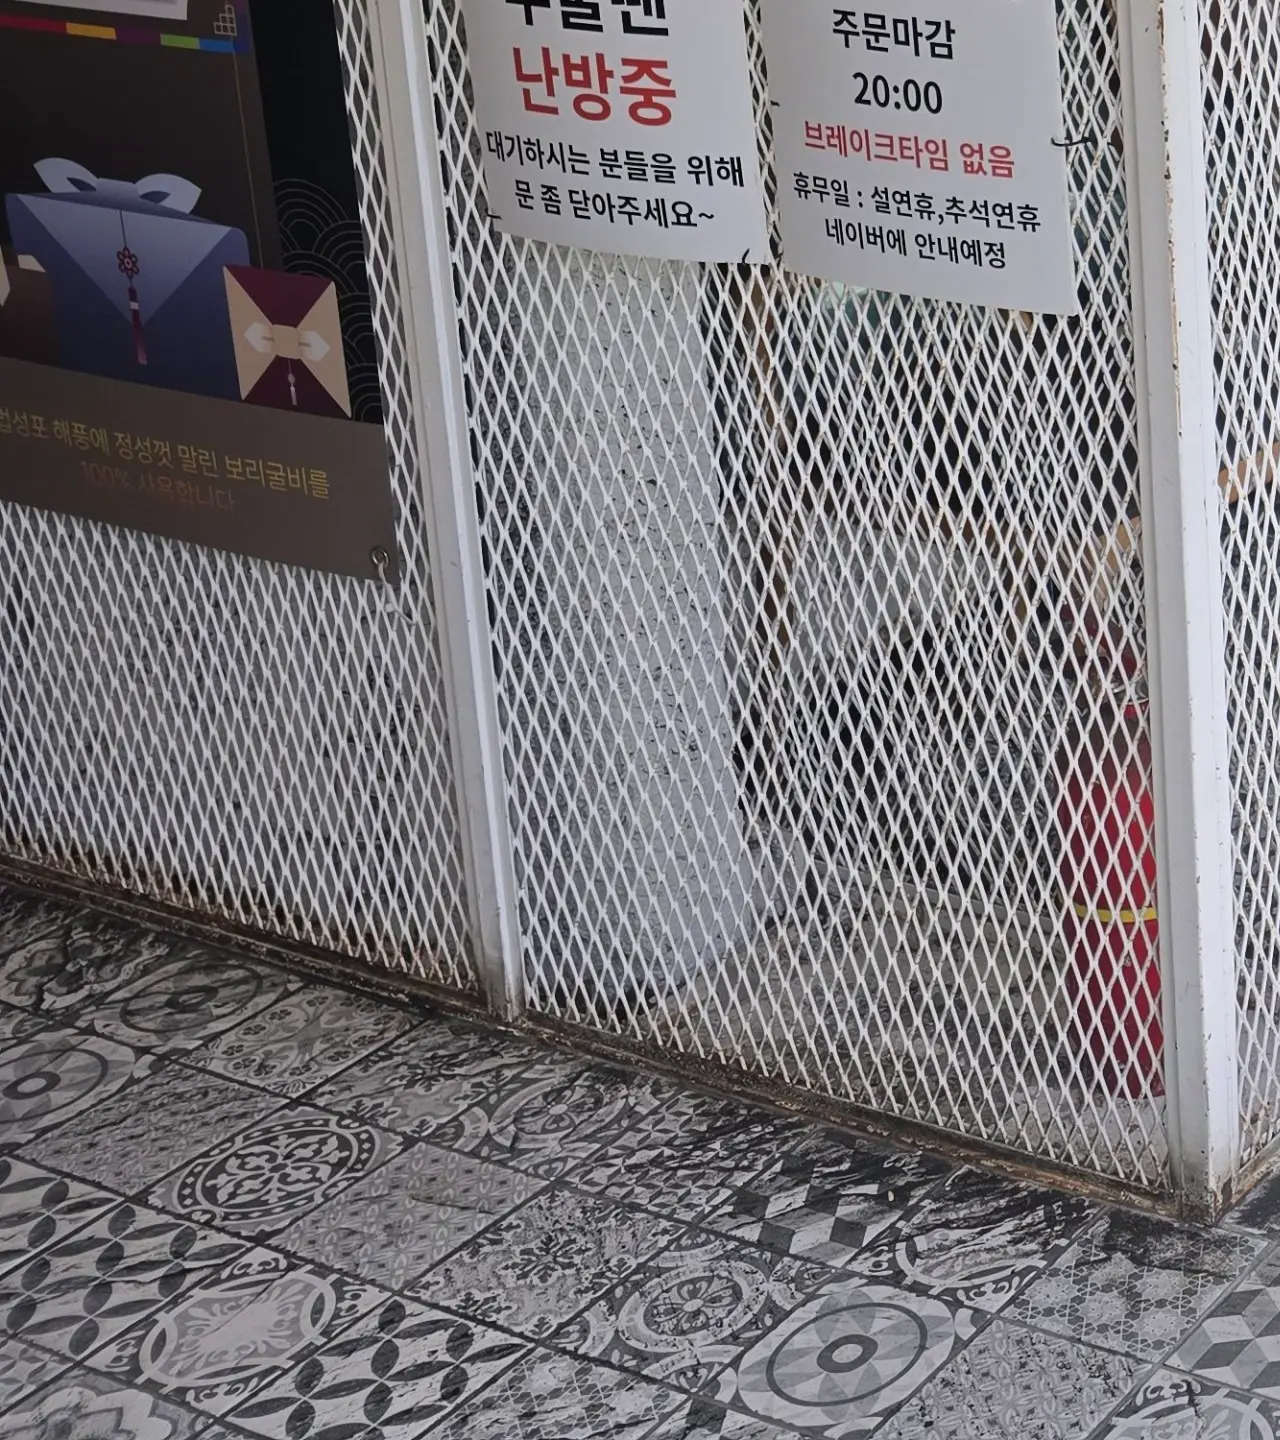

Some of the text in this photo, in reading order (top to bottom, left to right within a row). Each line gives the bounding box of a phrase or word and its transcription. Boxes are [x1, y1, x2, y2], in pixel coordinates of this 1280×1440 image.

[833, 9, 955, 60] 주문마감
[512, 45, 677, 126] 난방중
[853, 72, 944, 115] 20:00
[485, 130, 745, 189] 대기하시는 분들을 위해
[803, 121, 1015, 179] 브레이크타임 없음
[514, 179, 715, 228] 문 좀 닫아주세요~
[792, 171, 1041, 233] 휴무일 설연휴,추석연휴
[825, 219, 1006, 269] 네이버에 안내예정
[53, 419, 110, 456] 해풍에
[114, 432, 174, 469] 정성껏
[178, 445, 219, 478] 말린
[225, 455, 330, 501] 보리굴비를
